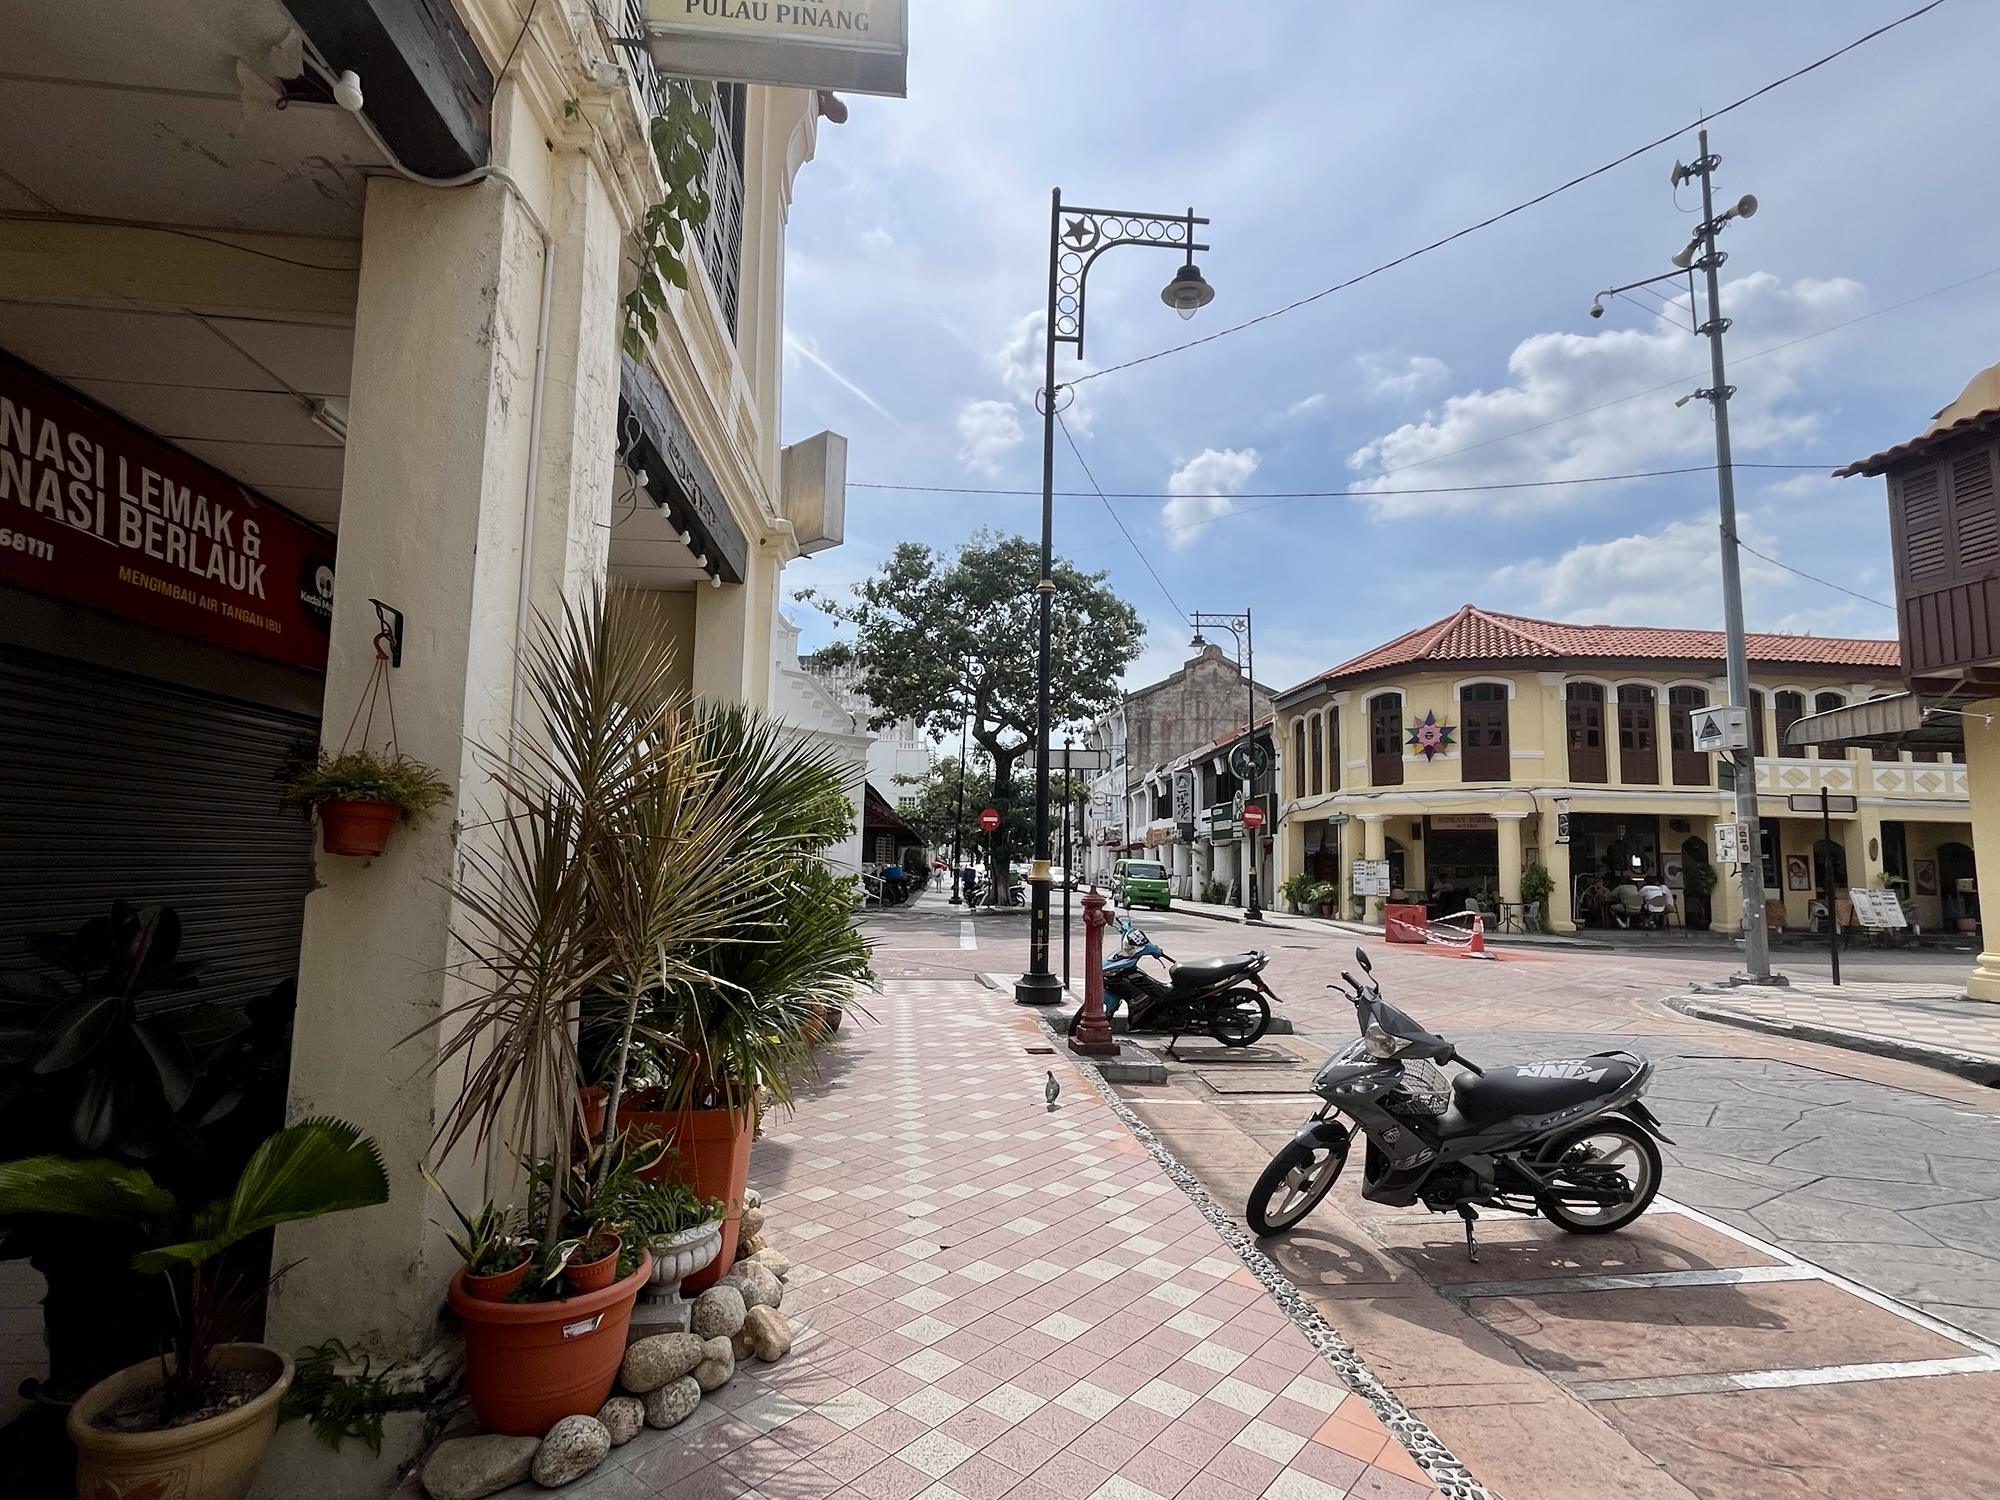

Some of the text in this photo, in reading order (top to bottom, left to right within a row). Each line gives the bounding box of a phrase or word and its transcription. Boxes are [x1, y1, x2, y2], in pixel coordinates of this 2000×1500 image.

[686, 0, 869, 31] PULAU PINANG
[0, 396, 261, 559] NASI LEMAK &
[0, 449, 266, 600] NASI BERLAUK
[0, 528, 54, 562] 68111
[119, 565, 282, 634] MENGIMBAU AIR TANGAN IBU
